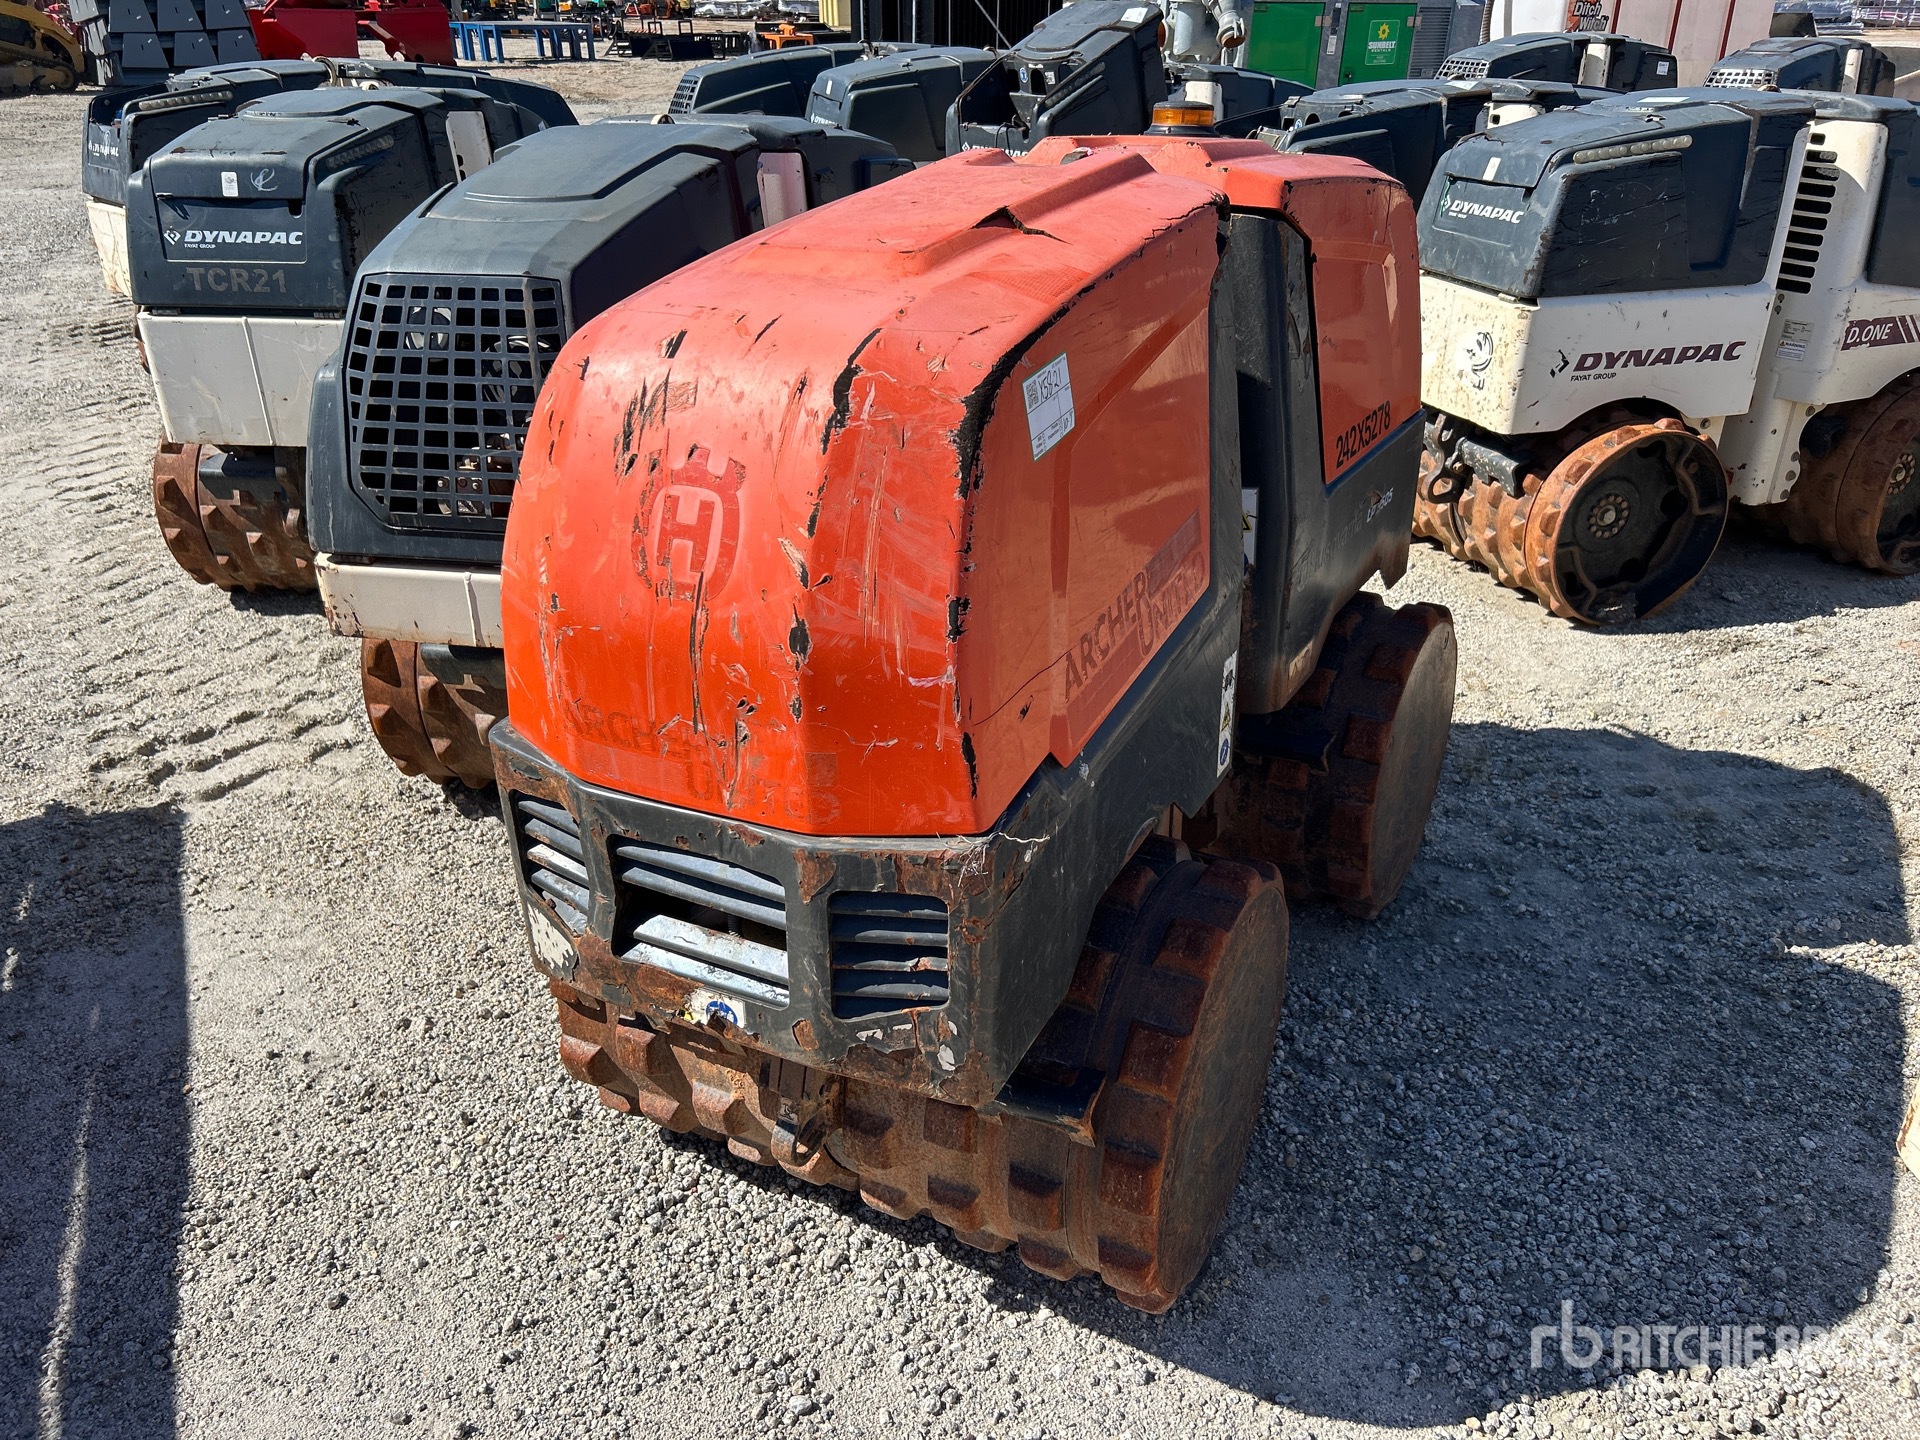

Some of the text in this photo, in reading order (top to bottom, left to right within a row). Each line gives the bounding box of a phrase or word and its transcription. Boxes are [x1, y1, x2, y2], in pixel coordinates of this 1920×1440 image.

[1573, 1, 1602, 16] Ditch
[1580, 16, 1607, 31] Witch
[1368, 41, 1396, 50] SUNBELT
[1450, 200, 1524, 224] DYNAPAC
[184, 230, 303, 245] DYNAPAC
[186, 267, 287, 293] TCR21
[1847, 323, 1893, 343] D.ONE
[1573, 341, 1746, 372] DYNAPAC
[1570, 372, 1617, 382] FAYAT GROUP
[1335, 400, 1391, 469] 242X5278
[1065, 571, 1148, 703] ARCHER
